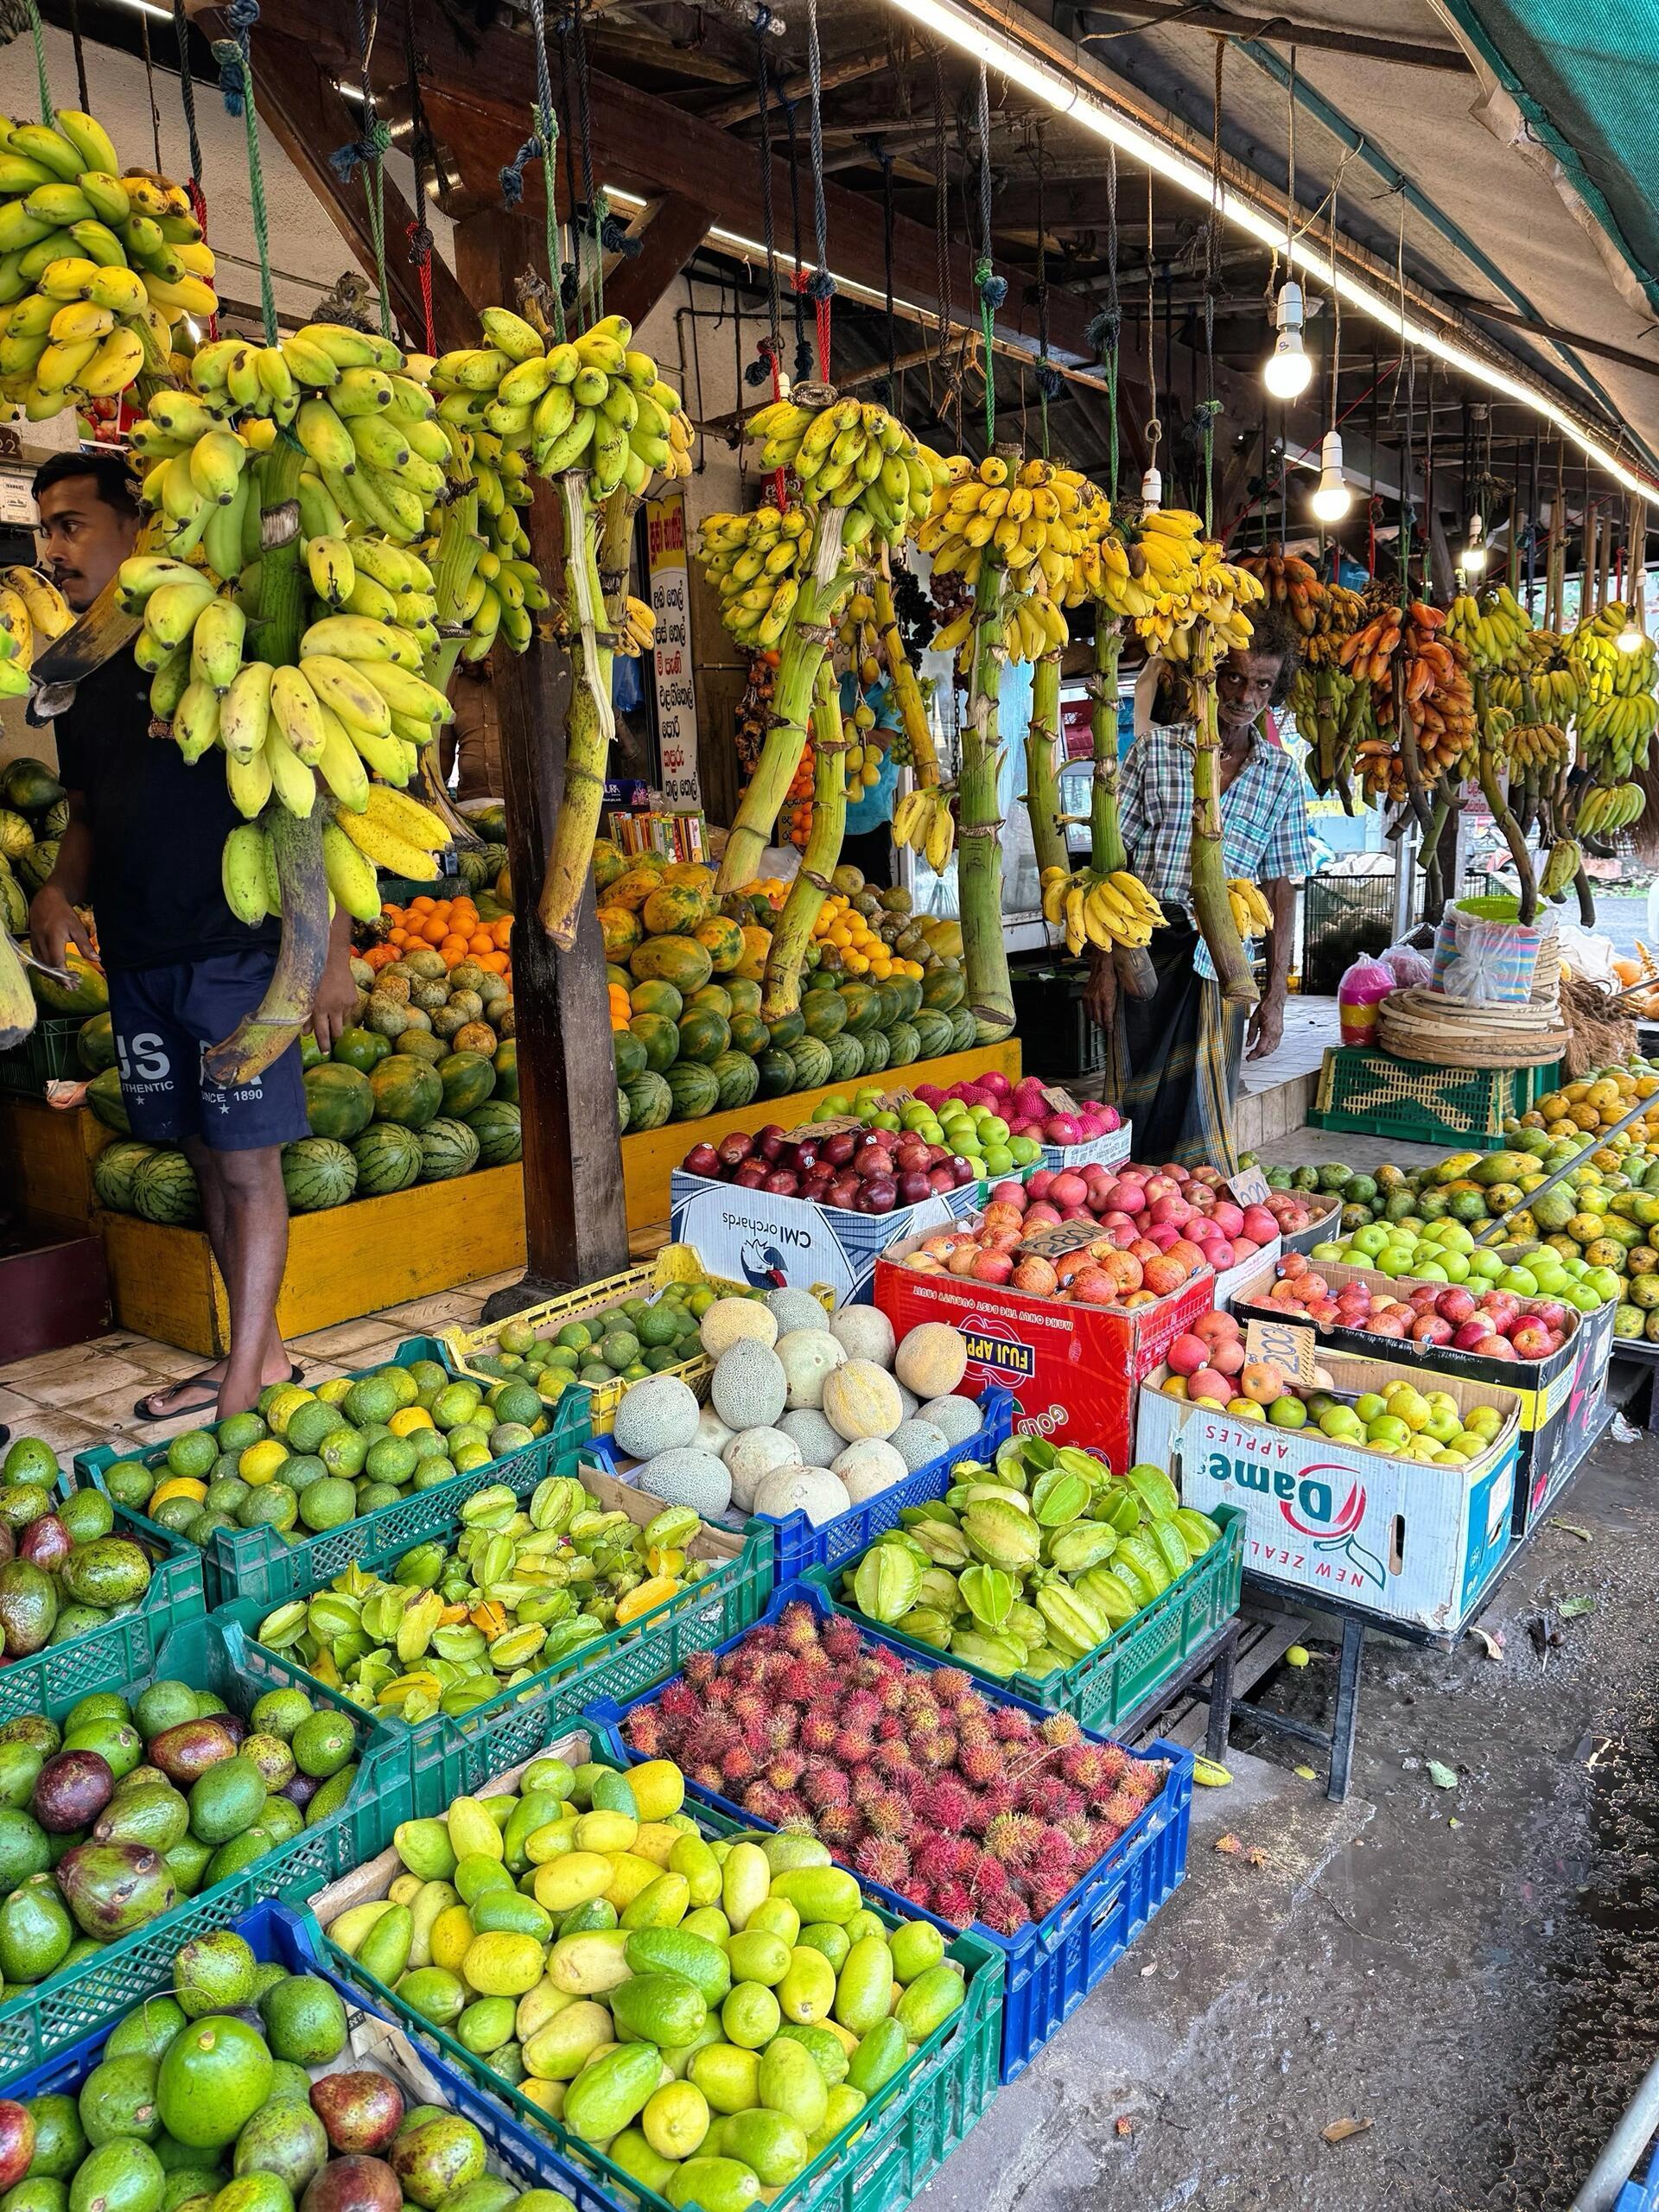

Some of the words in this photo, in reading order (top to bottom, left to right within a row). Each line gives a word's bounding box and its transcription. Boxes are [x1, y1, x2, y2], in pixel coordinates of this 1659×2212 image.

[233, 1089, 264, 1102] 1890
[722, 1212, 779, 1236] orchards
[780, 1226, 812, 1249] CMI
[912, 1285, 938, 1300] FRUIT
[938, 1292, 976, 1309] QUALITY
[976, 1300, 999, 1315] BEST
[999, 1306, 1018, 1319] THE
[1018, 1310, 1045, 1325] ONLY
[1045, 1316, 1074, 1332] MAKE
[961, 1334, 994, 1361] APP
[996, 1344, 1028, 1370] FUJI
[1205, 1425, 1289, 1459] APPLES
[1209, 1452, 1332, 1523] Dame
[1244, 1539, 1306, 1570] ZEAL
[1315, 1561, 1365, 1588] NEW
